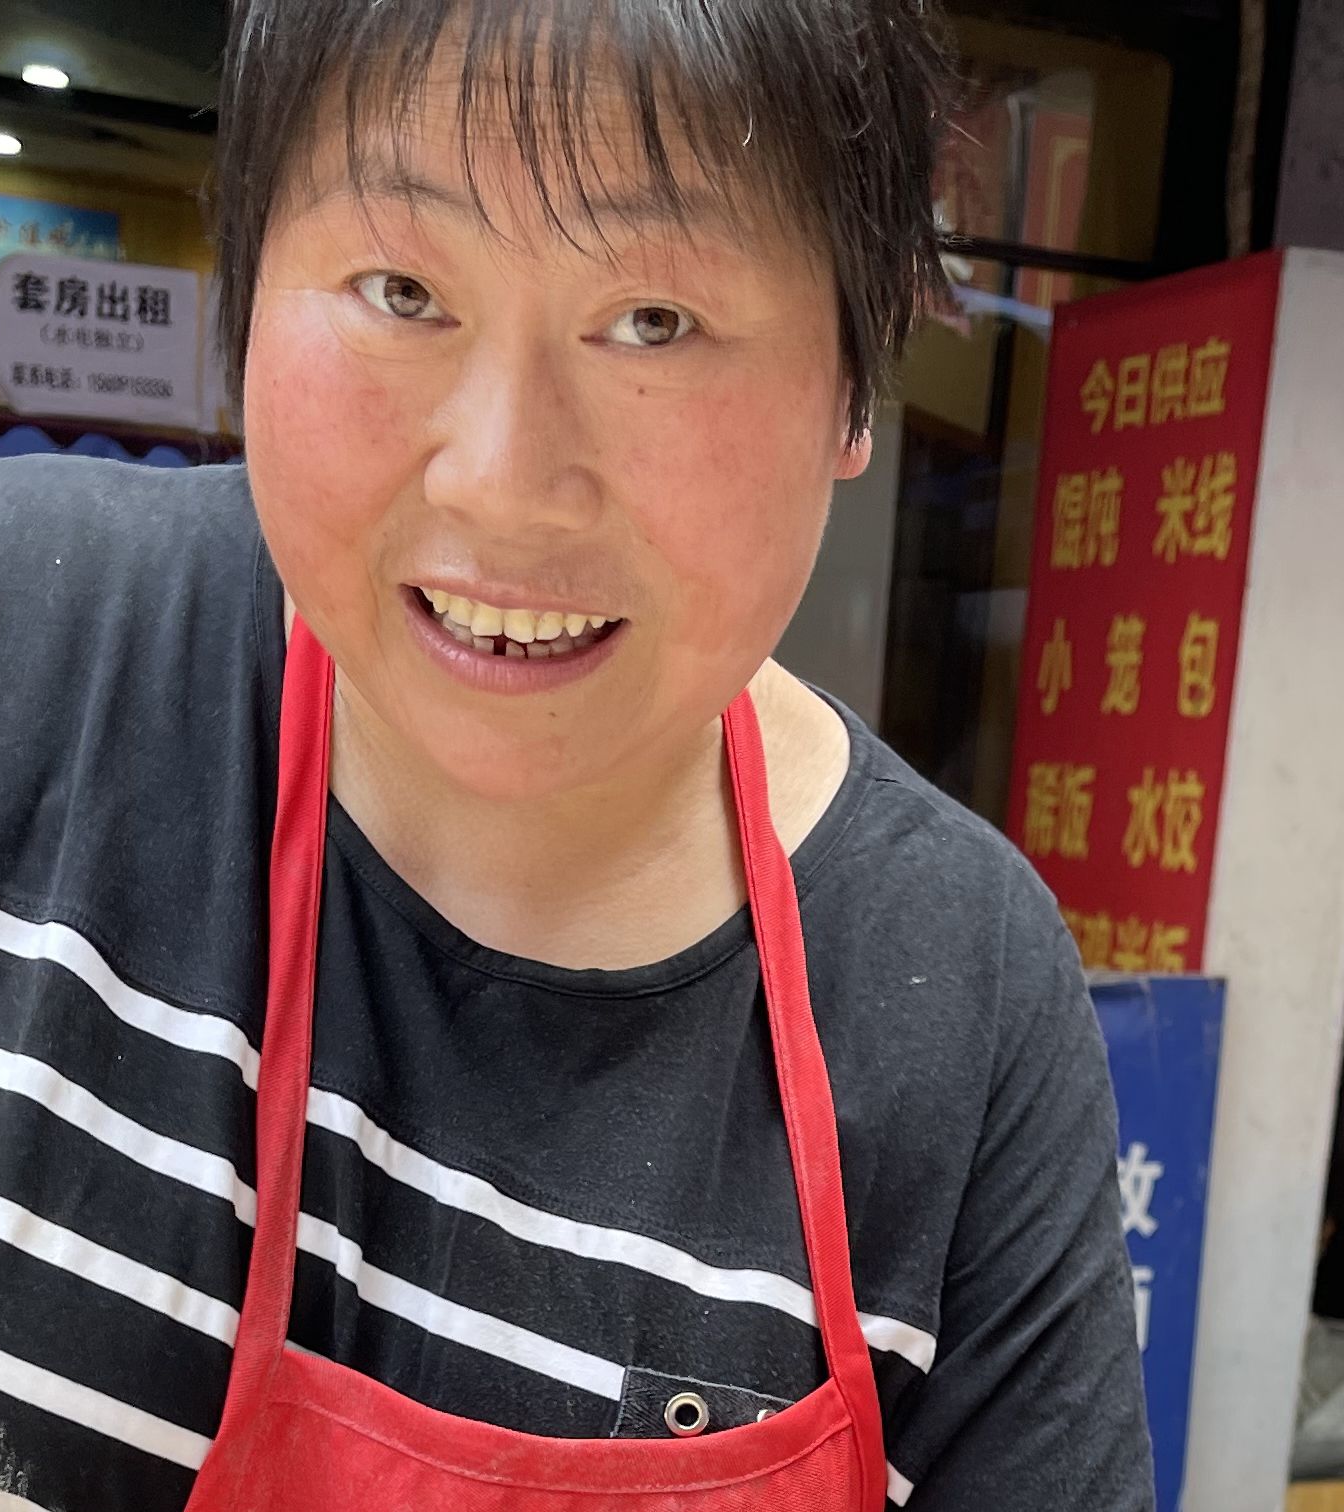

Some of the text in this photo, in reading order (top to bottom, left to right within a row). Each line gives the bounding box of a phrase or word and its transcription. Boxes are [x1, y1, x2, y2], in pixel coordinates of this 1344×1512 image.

[12, 270, 172, 327] 套房出租
[1080, 336, 1231, 434] 今日供应
[1152, 451, 1237, 565] 米线
[1037, 609, 1219, 718] 小笼包
[1123, 768, 1204, 873] 水饺
